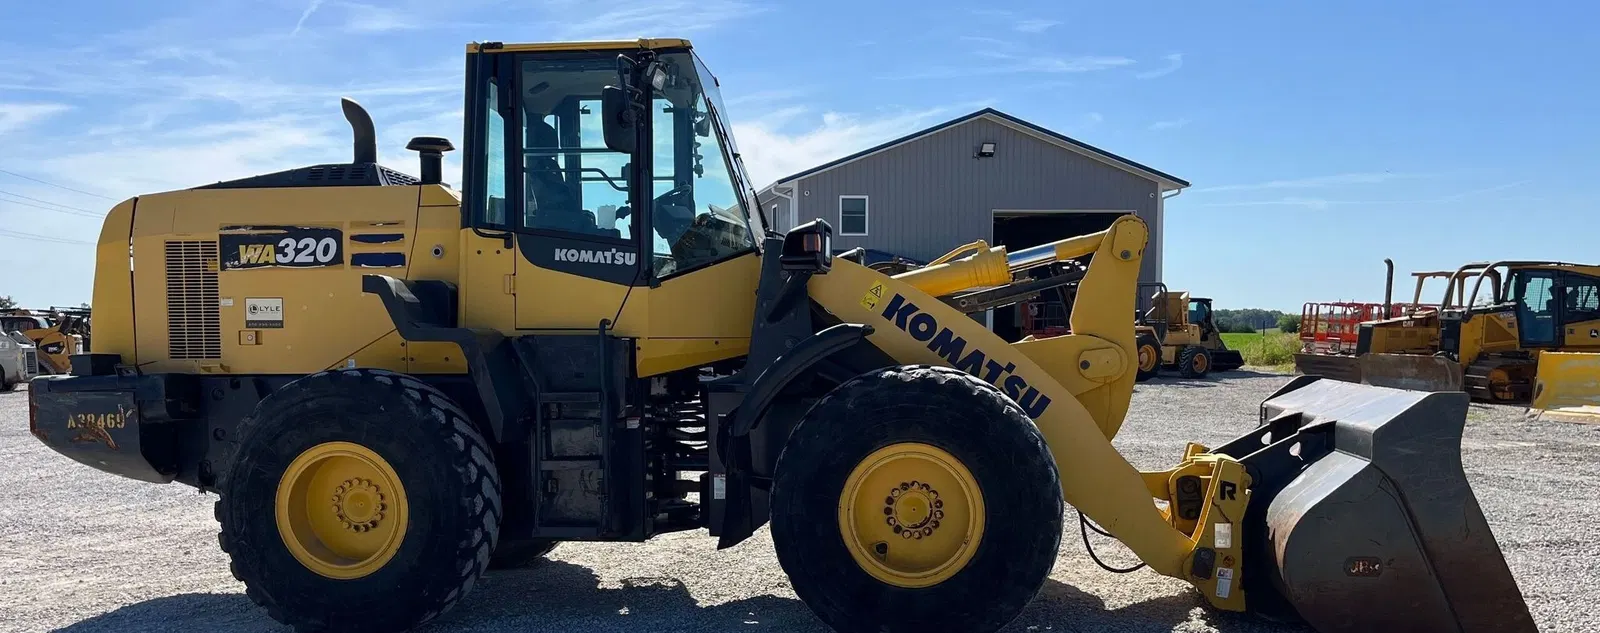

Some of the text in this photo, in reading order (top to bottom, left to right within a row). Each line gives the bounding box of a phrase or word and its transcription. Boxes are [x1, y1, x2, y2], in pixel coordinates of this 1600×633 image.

[239, 237, 337, 264] WA320
[554, 248, 636, 266] KOMATSU
[881, 293, 1052, 419] KOMATSU
[67, 412, 125, 429] A38469
